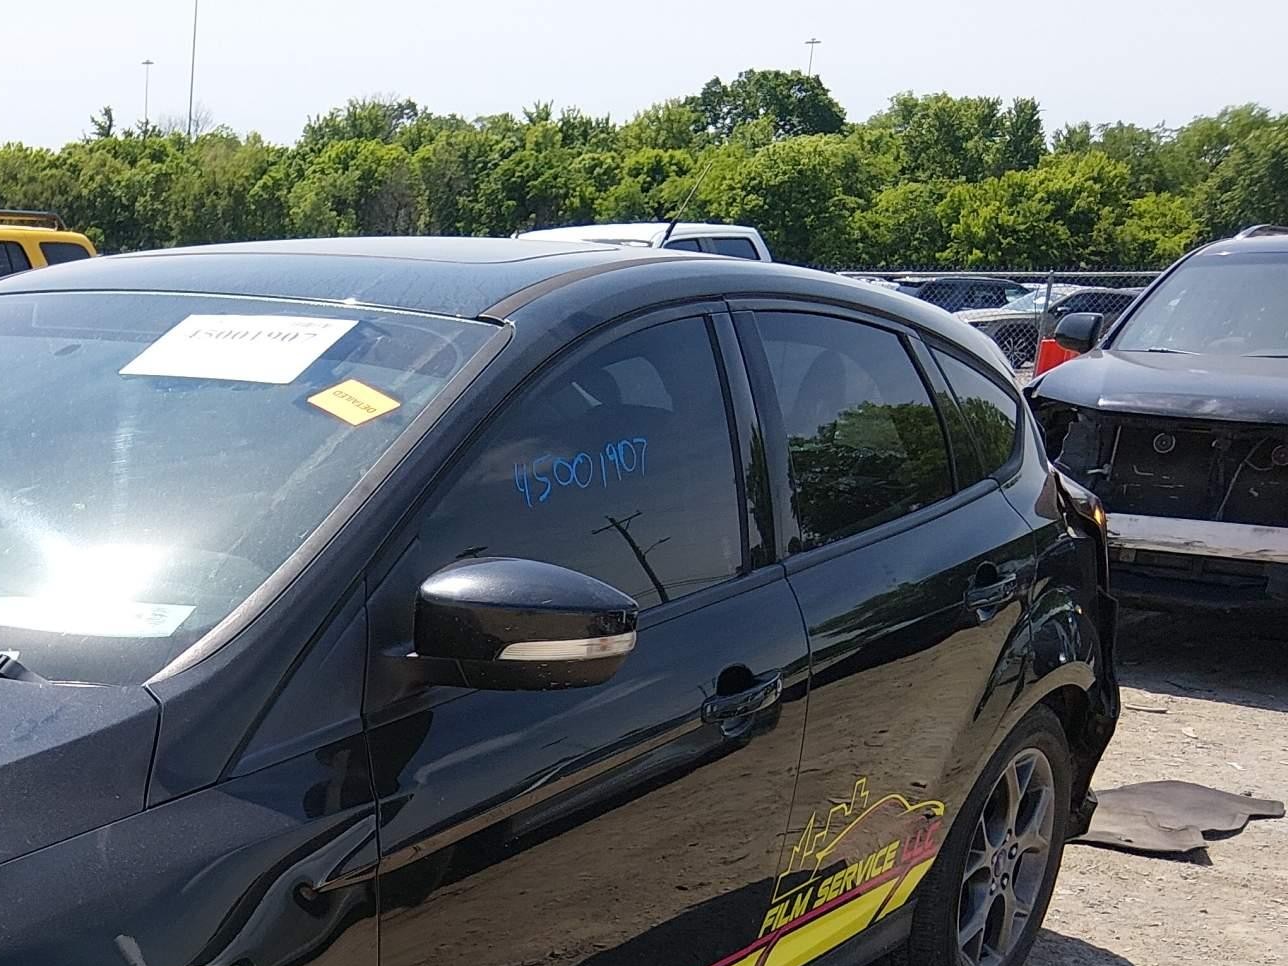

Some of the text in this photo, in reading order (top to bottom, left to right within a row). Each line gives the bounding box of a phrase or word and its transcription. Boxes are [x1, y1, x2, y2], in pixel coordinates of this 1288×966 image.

[332, 389, 377, 414] DETAILED
[514, 438, 647, 508] 45001907
[758, 886, 815, 938] FILM
[813, 839, 900, 909] SERVICE
